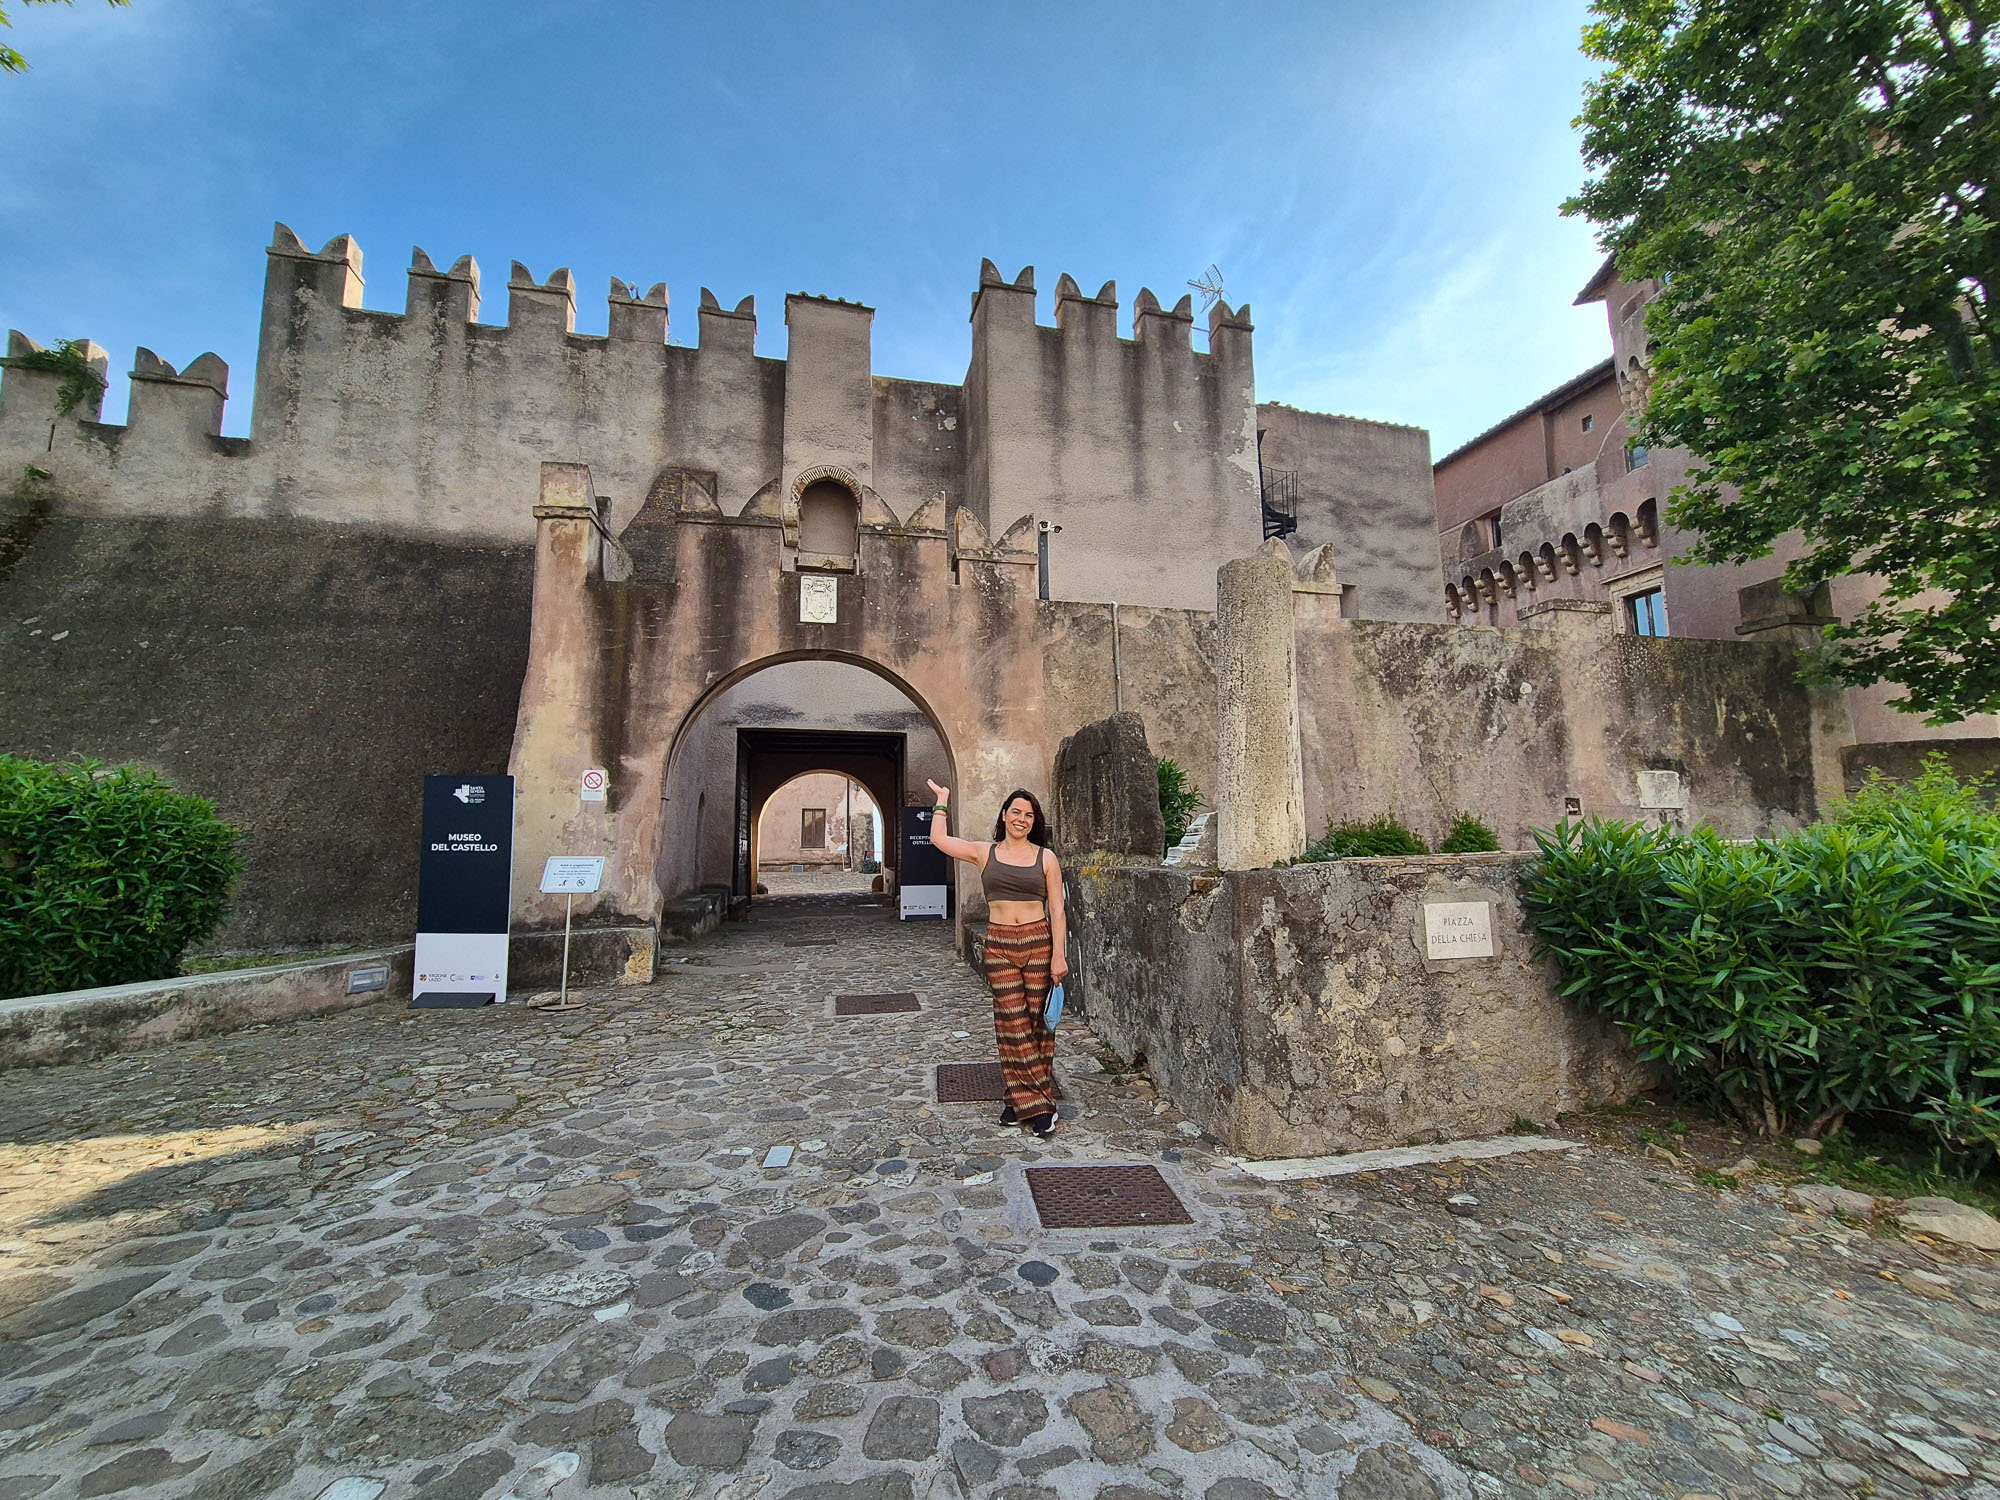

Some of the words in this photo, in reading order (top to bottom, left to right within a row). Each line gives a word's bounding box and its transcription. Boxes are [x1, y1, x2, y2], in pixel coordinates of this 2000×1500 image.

[1443, 917, 1474, 926] PIAZZA
[1431, 935, 1457, 944] DELLA
[1460, 933, 1487, 943] CHIESA
